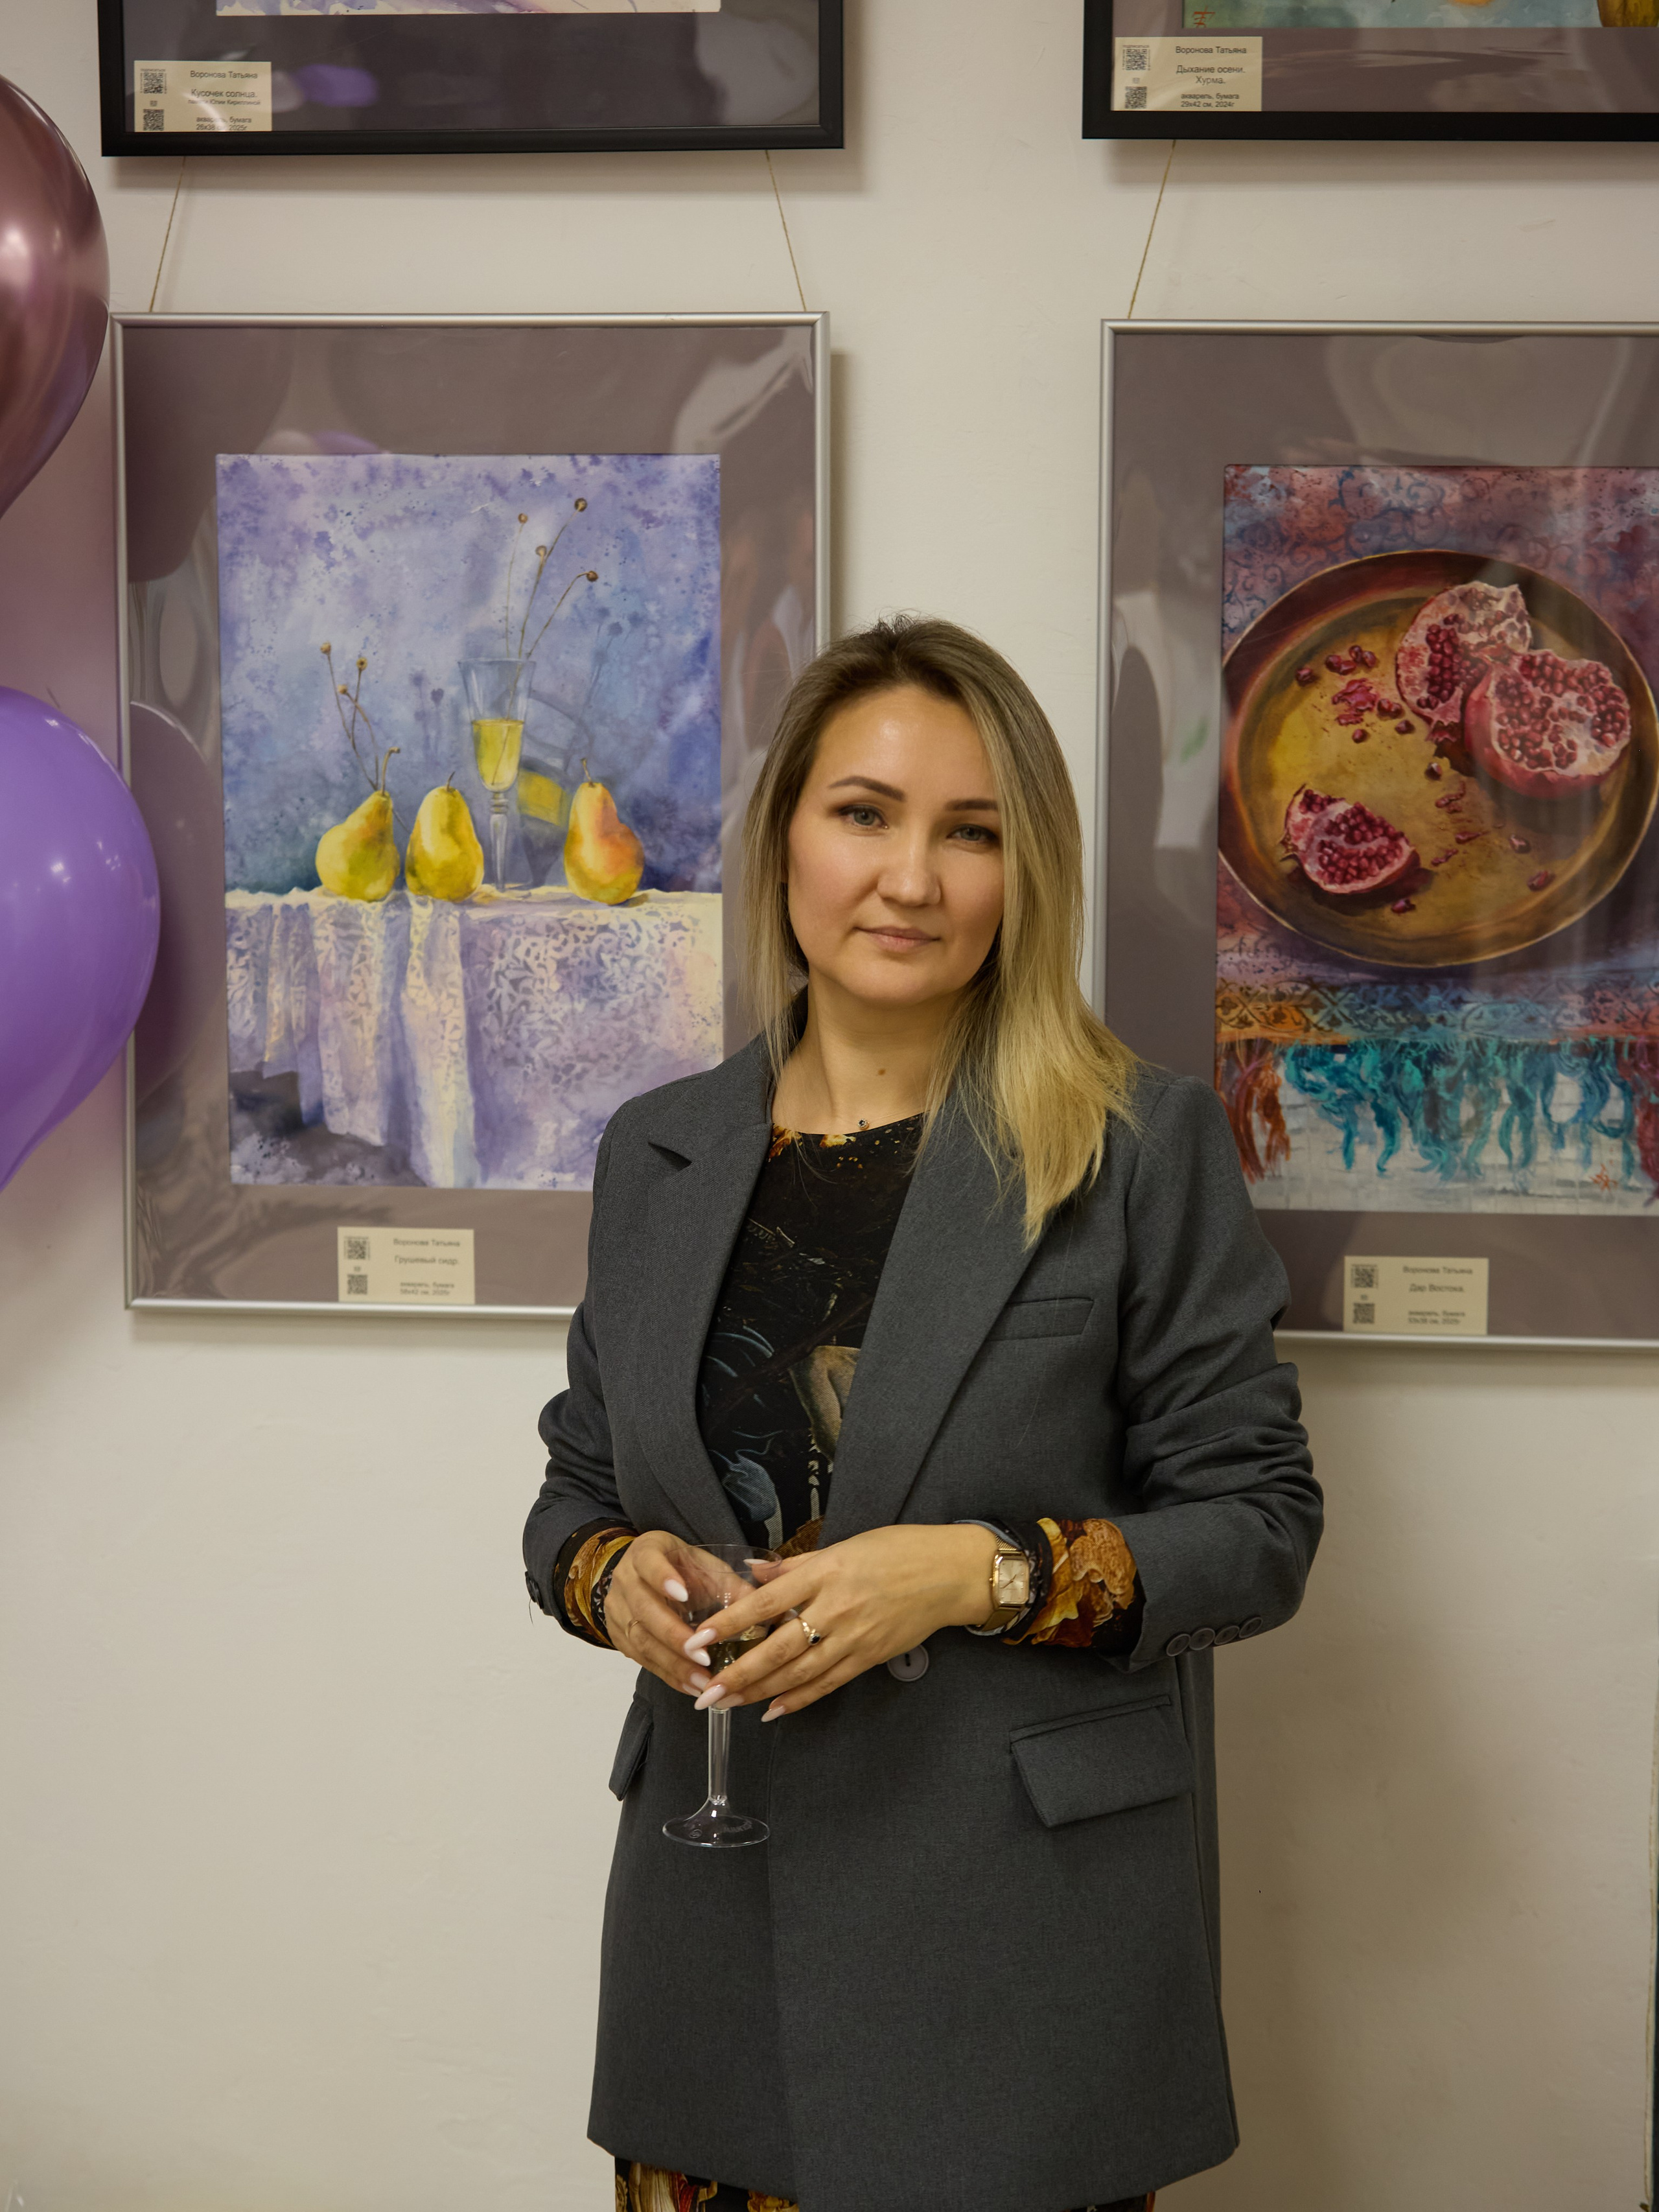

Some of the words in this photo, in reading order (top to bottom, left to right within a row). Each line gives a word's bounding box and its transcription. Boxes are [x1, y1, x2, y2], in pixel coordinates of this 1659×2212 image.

[1176, 65, 1214, 75] Дыхание
[190, 71, 226, 79] Воронова
[228, 71, 258, 79] Татьяна
[1196, 76, 1226, 85] Хурма.
[191, 89, 224, 99] Кусочек
[226, 90, 257, 99] солнца.
[394, 1255, 435, 1264] Грушевый
